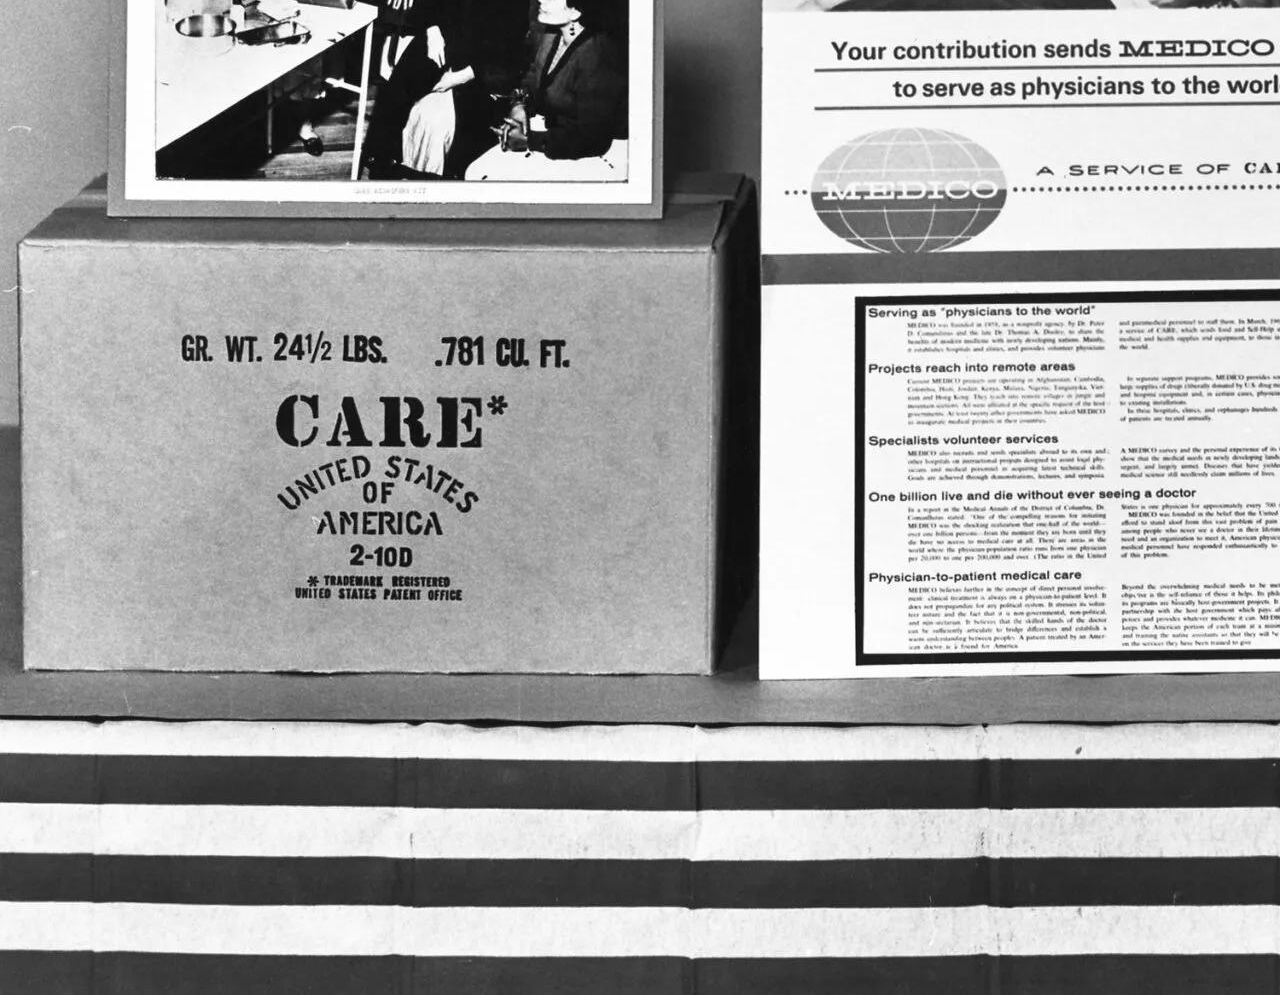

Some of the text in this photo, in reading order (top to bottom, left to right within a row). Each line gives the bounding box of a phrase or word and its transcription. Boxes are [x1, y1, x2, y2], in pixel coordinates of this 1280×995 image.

[831, 41, 887, 61] Your
[893, 39, 1036, 60] contribution
[1044, 38, 1111, 58] sends
[1119, 39, 1275, 57] MEDICO
[892, 81, 917, 98] to
[922, 82, 984, 97] serve
[990, 82, 1016, 96] as
[1022, 76, 1144, 100] physicians
[1151, 78, 1175, 95] to
[1182, 75, 1220, 94] the
[1036, 166, 1054, 176] A
[1069, 164, 1182, 176] SERVICE
[1196, 164, 1230, 175] OF
[822, 180, 998, 202] MEDICO
[868, 306, 917, 320] Serving
[921, 309, 937, 318] as
[1016, 307, 1029, 317] to
[1032, 306, 1052, 317] the
[181, 334, 213, 362] GR.
[225, 335, 262, 363] WT.
[342, 334, 388, 364] LBS.
[434, 335, 485, 367] .781
[496, 337, 530, 368] CU.
[539, 339, 570, 368] FT.
[868, 362, 1076, 376] Projects reach into remote areas
[869, 434, 1059, 448] Specialists volunteer services
[276, 455, 479, 513] UNITED STATES
[363, 481, 395, 504] OF
[869, 488, 1196, 502] One billion live and die without ever seeing a doctor
[317, 510, 443, 536] AMERICA
[350, 544, 413, 568] 2-10D
[323, 575, 450, 588] TRADEMARK REGISTERED
[869, 570, 1082, 584] Physician-to-patient medical care
[295, 588, 463, 601] UNITED STATES PATENT OFFICE
